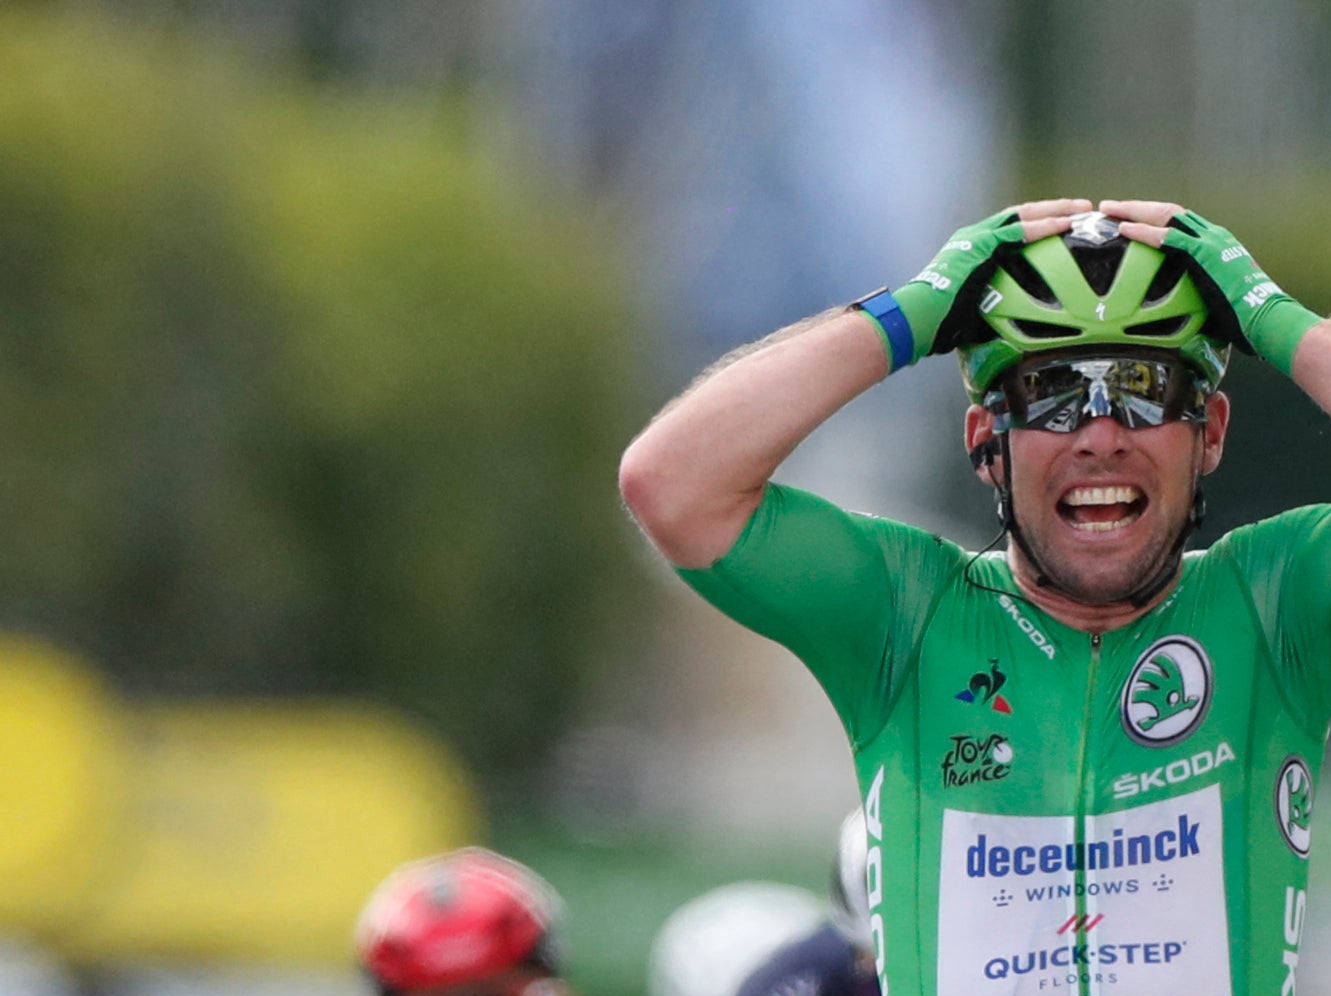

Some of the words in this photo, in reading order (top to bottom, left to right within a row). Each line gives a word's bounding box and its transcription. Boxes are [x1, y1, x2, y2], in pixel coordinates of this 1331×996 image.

[1112, 742, 1236, 800] ŠKODA
[966, 813, 1201, 878] deceuninck
[1026, 878, 1140, 902] WINDOWS
[1039, 973, 1119, 990] FLOORS
